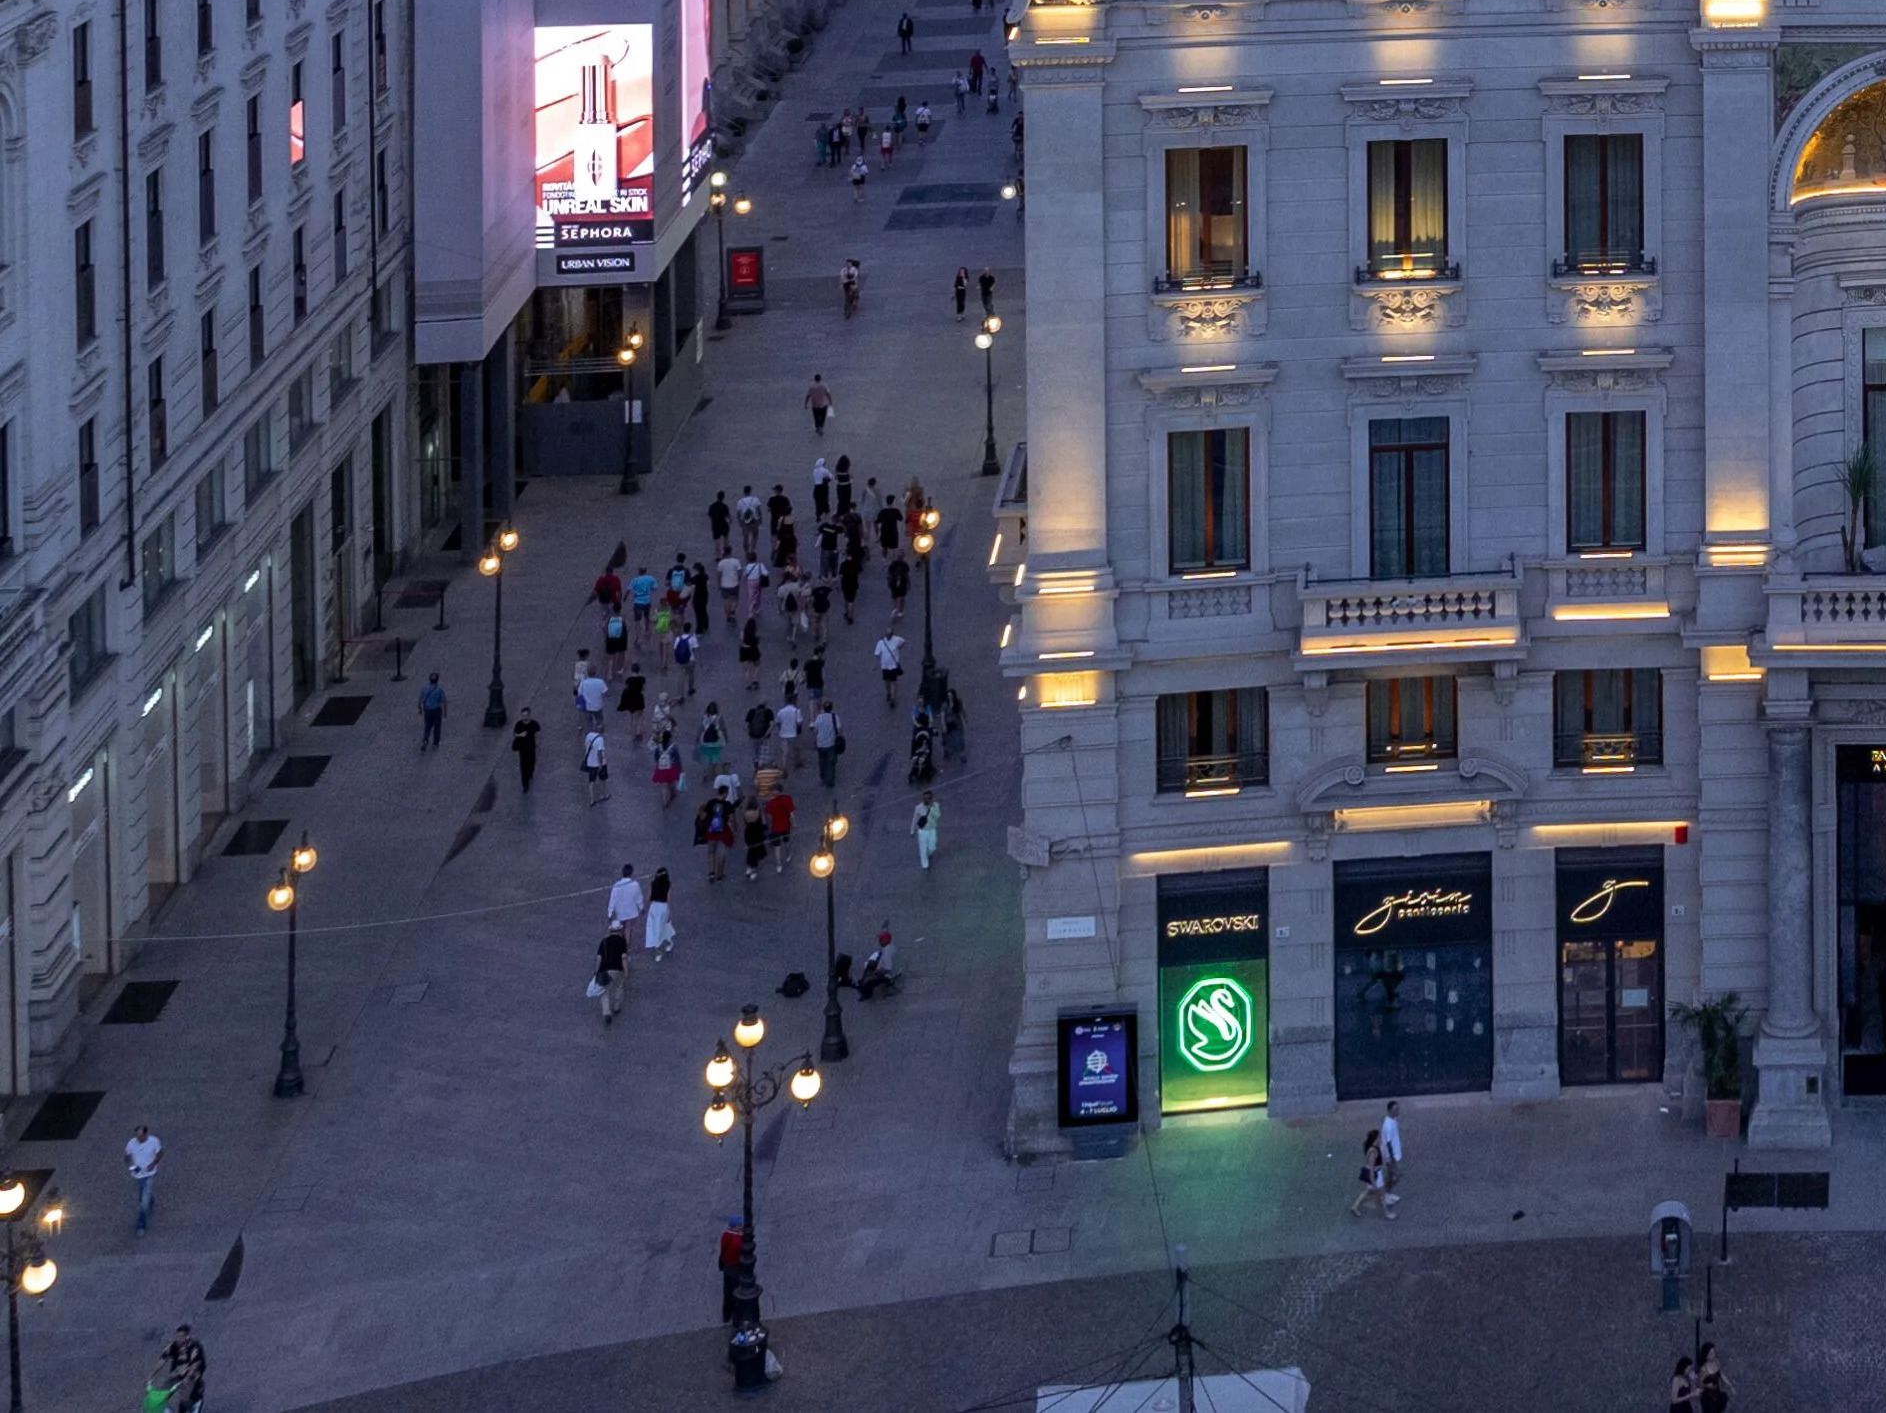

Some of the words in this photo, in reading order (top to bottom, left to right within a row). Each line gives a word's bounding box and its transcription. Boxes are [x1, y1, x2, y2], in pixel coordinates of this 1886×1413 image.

[543, 198, 607, 215] UNREAL
[609, 197, 649, 213] SKIN
[561, 226, 633, 240] SEPHORA
[561, 259, 595, 270] URBAN
[597, 257, 630, 268] VISION
[1873, 762, 1881, 772] A
[1166, 914, 1260, 938] SWAROVSKI
